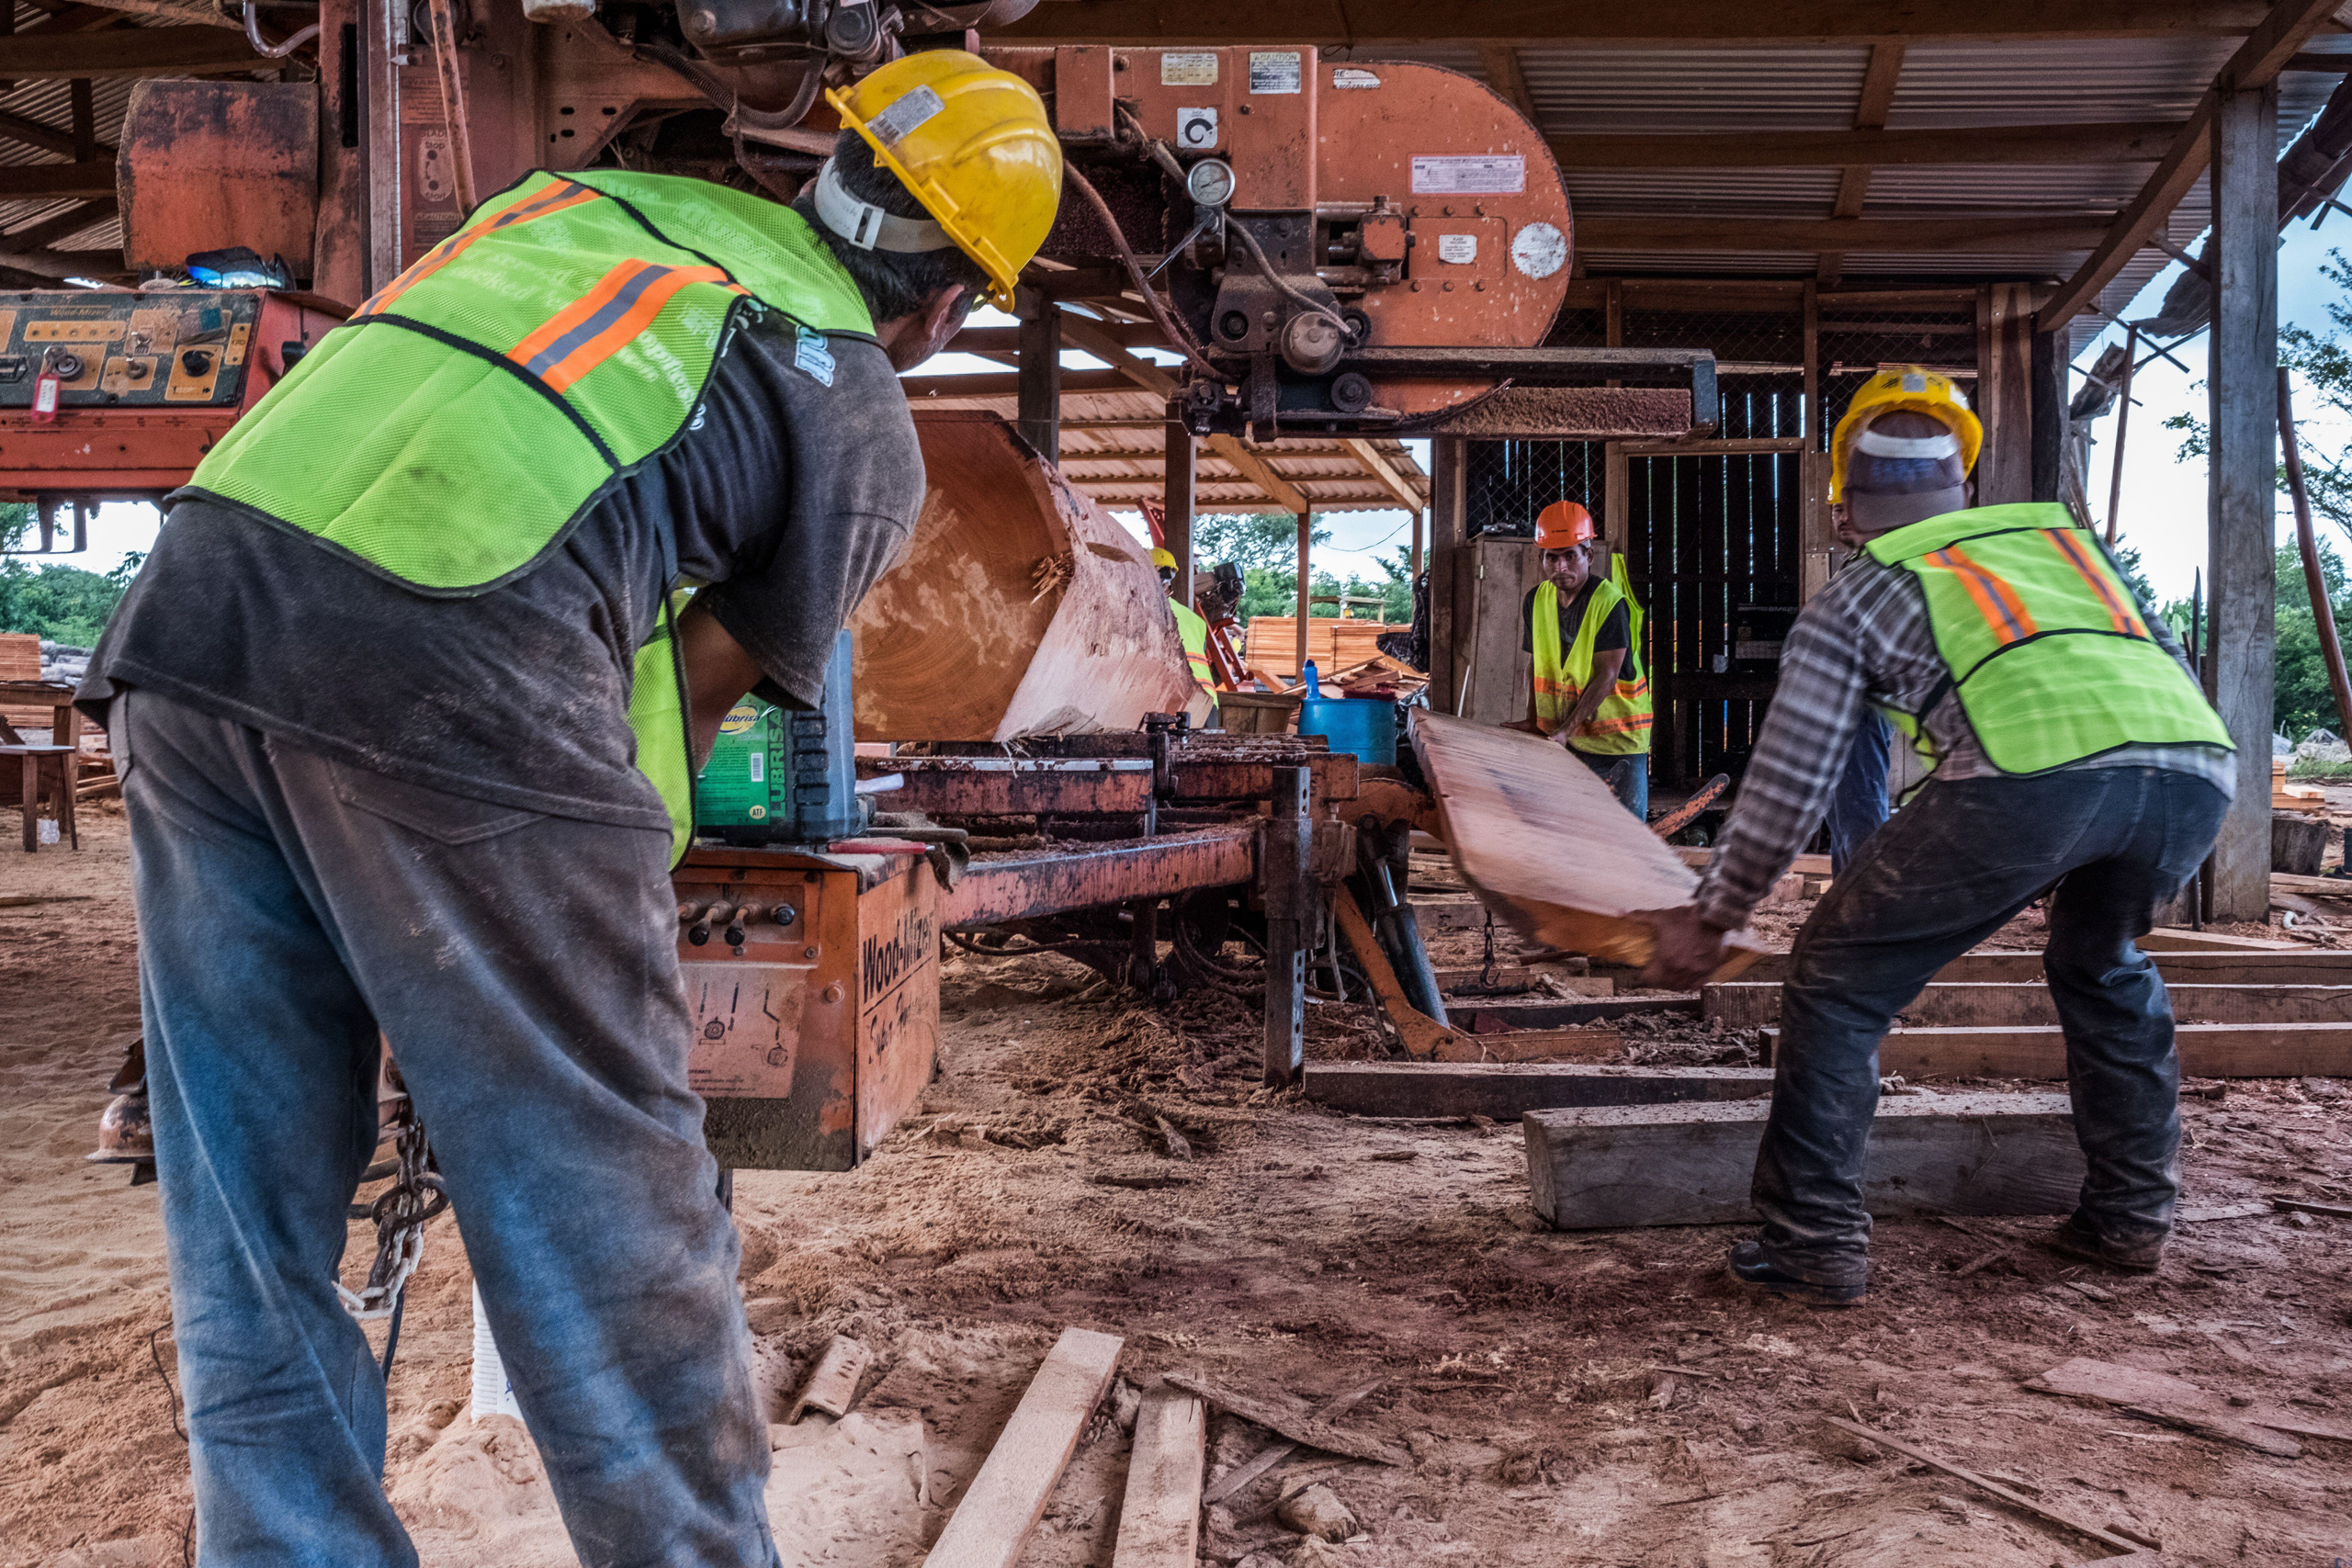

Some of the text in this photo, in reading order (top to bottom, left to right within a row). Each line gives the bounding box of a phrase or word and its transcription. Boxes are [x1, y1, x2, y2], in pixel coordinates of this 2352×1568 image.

[424, 141, 446, 150] Stop
[724, 714, 761, 723] ubrisa
[768, 710, 786, 818] LUBRISA
[752, 808, 763, 817] ATF
[863, 907, 933, 1004] Wood-Mizer
